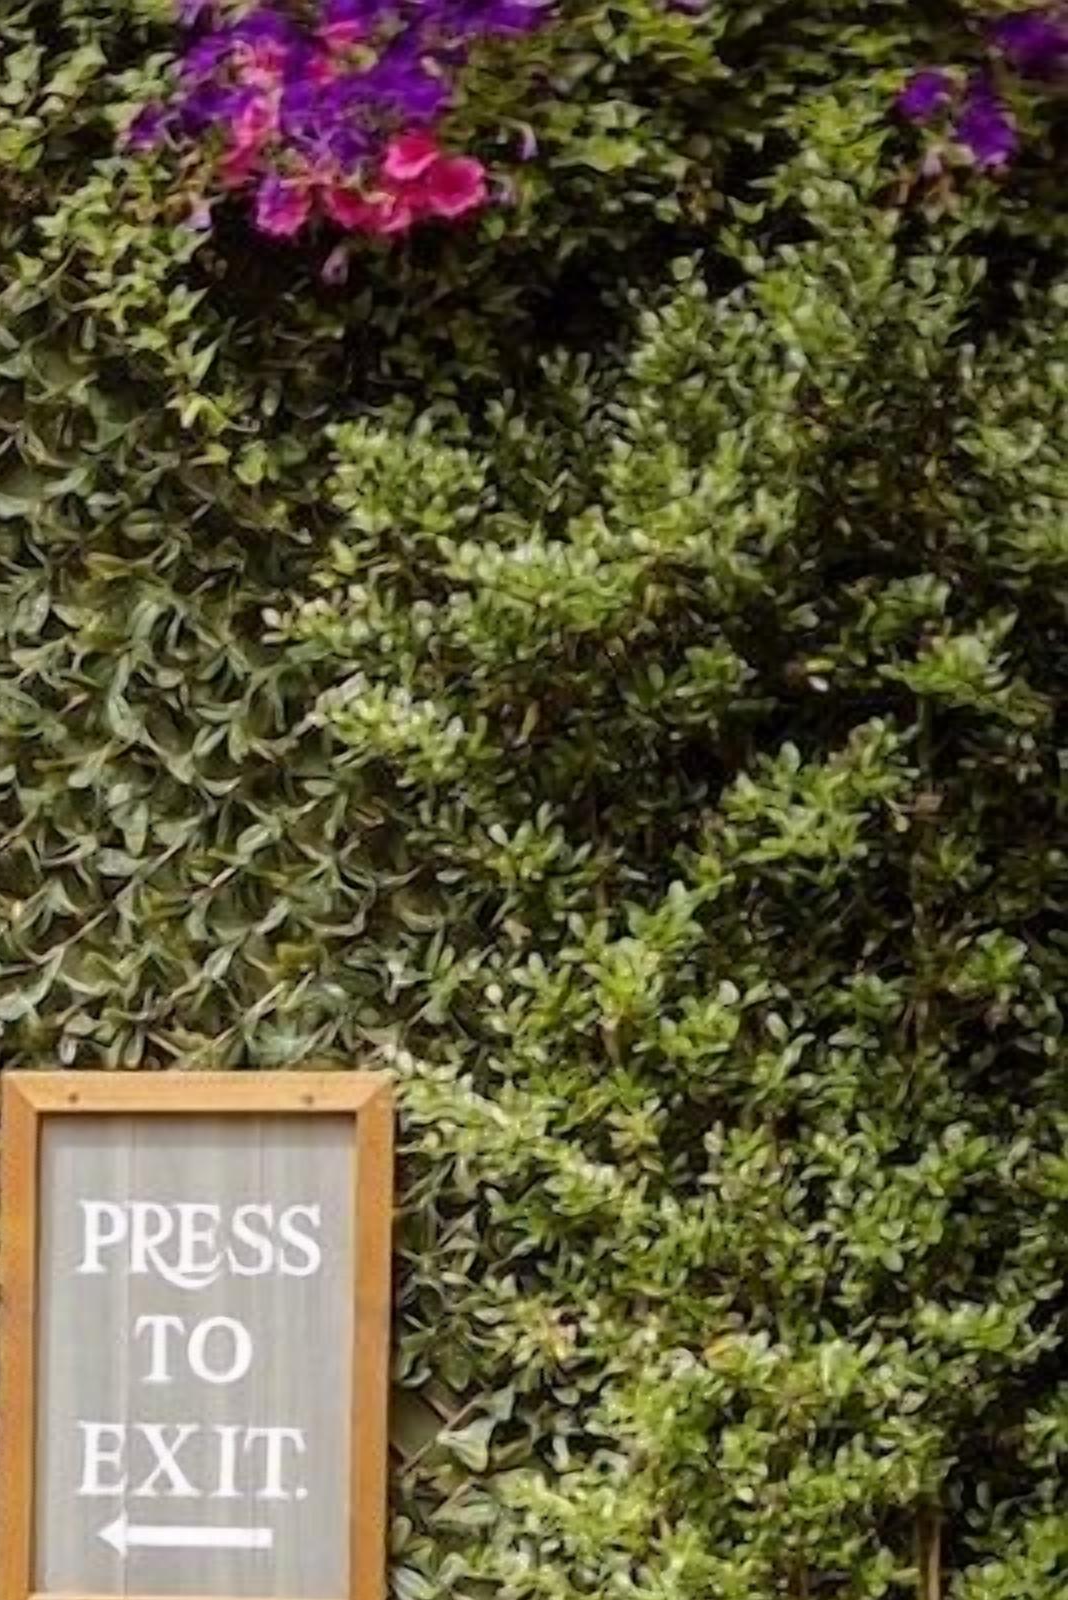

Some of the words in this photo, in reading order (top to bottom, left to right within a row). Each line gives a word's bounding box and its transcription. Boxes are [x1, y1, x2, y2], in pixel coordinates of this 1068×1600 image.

[78, 1200, 322, 1288] PRESS
[135, 1314, 253, 1384] TO
[78, 1422, 309, 1499] EXIT.
